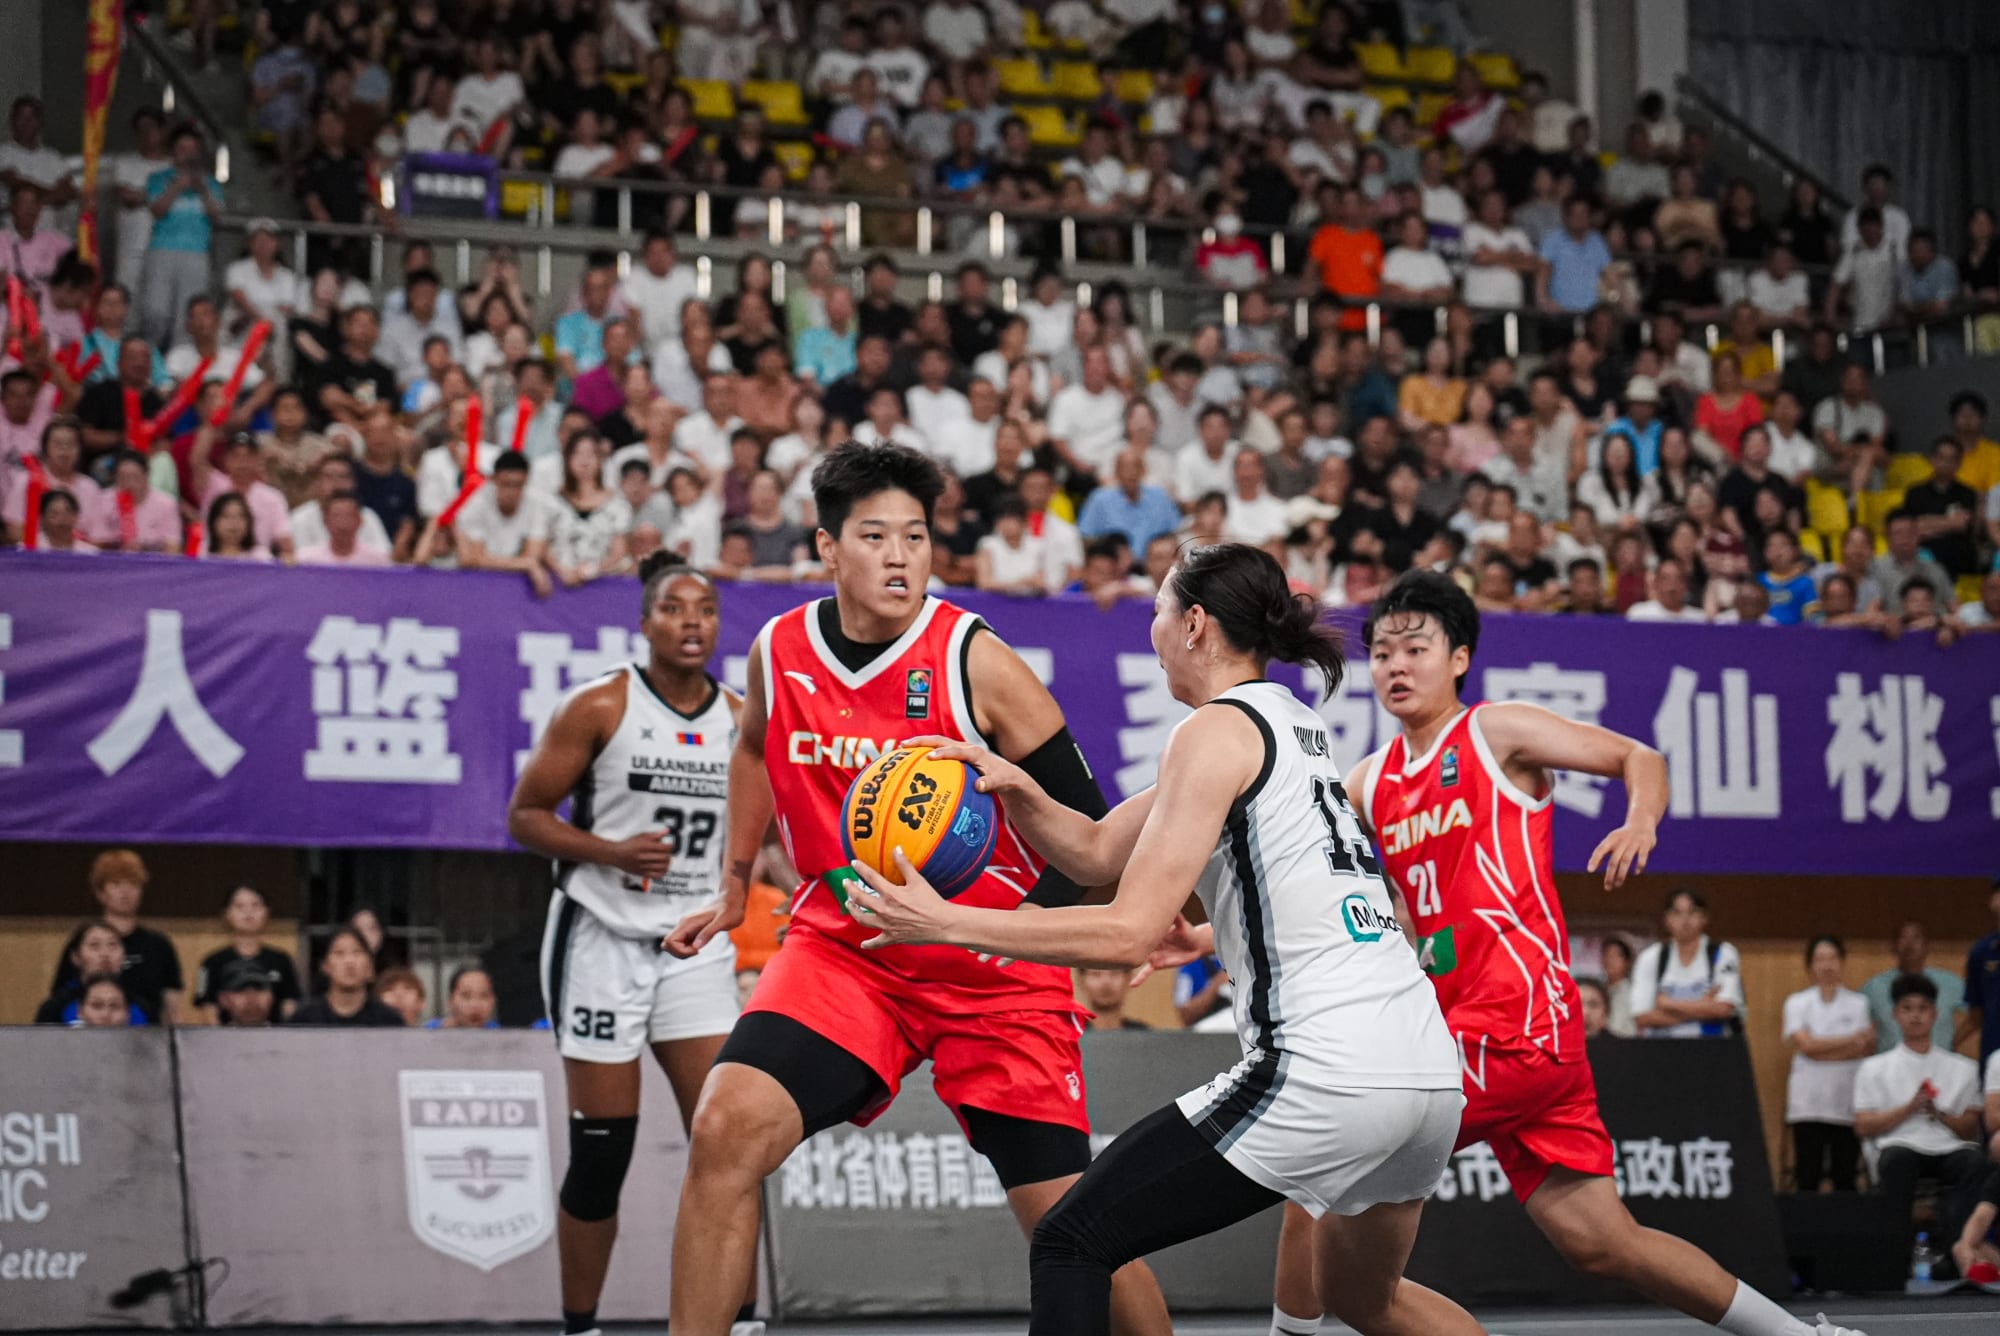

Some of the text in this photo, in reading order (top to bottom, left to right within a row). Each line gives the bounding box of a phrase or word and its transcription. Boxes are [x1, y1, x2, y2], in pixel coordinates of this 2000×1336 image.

[631, 755, 728, 776] ULAANBAAT
[788, 730, 899, 770] CHIN
[649, 775, 728, 797] AMAZON
[1407, 860, 1442, 917] 21
[572, 1006, 617, 1041] 32
[423, 1101, 524, 1126] RAPID
[0, 1112, 81, 1167] SHI
[0, 1241, 88, 1281] etter
